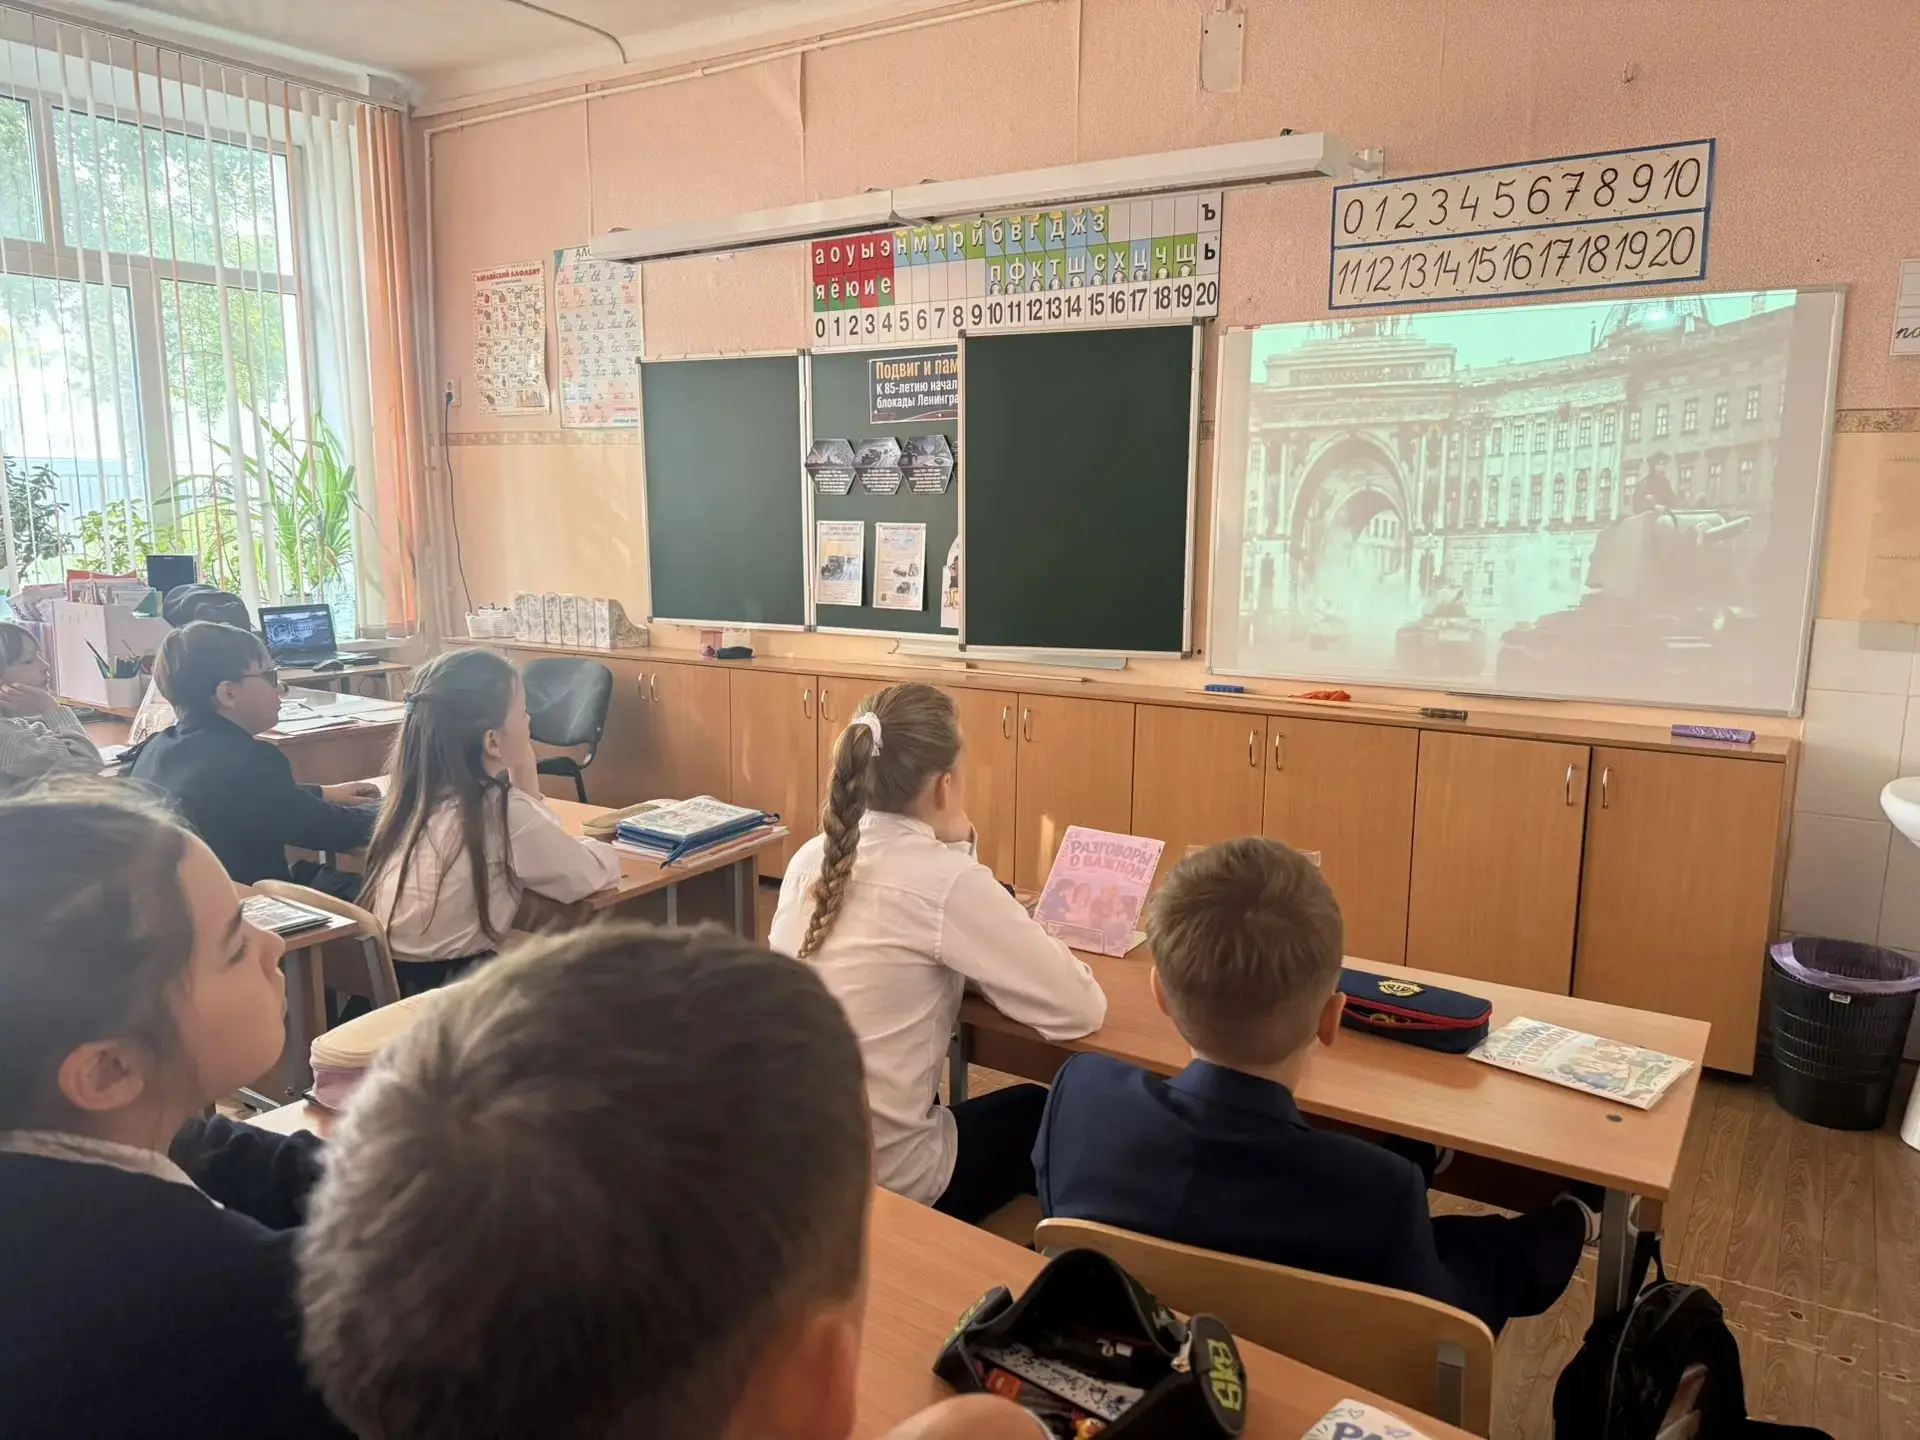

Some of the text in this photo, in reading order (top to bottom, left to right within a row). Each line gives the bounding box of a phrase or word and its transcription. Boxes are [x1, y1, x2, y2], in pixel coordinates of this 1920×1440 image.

[1343, 157, 1701, 234] 0 1 2 3 4 5 6 7 8 9 10
[816, 248, 825, 264] а
[861, 242, 874, 259] ы
[880, 240, 890, 256] э
[972, 220, 983, 246] й
[992, 219, 1003, 244] б
[1051, 219, 1064, 241] д
[816, 284, 825, 299] я
[831, 277, 840, 298] ё
[846, 281, 859, 297] ю
[865, 279, 875, 295] и
[881, 277, 891, 293] е
[1009, 257, 1025, 286] ф
[1134, 249, 1147, 271] ц
[1176, 244, 1196, 265] щ
[1338, 226, 1696, 295] 11 12 13 14 15 16 17 18 19 20
[816, 281, 1217, 338] 0 1 2 3 4 5 6 7 8 9 10 11 12 13 14 15 16 17 18 19 20
[875, 360, 921, 380] Подвиг
[923, 360, 932, 375] и
[876, 384, 883, 395] К
[884, 381, 928, 395] 85-летию
[877, 396, 916, 409] блокады
[1069, 854, 1148, 881] О ВАЖНОМ
[1070, 840, 1153, 866] РАЗГОВОРЫ
